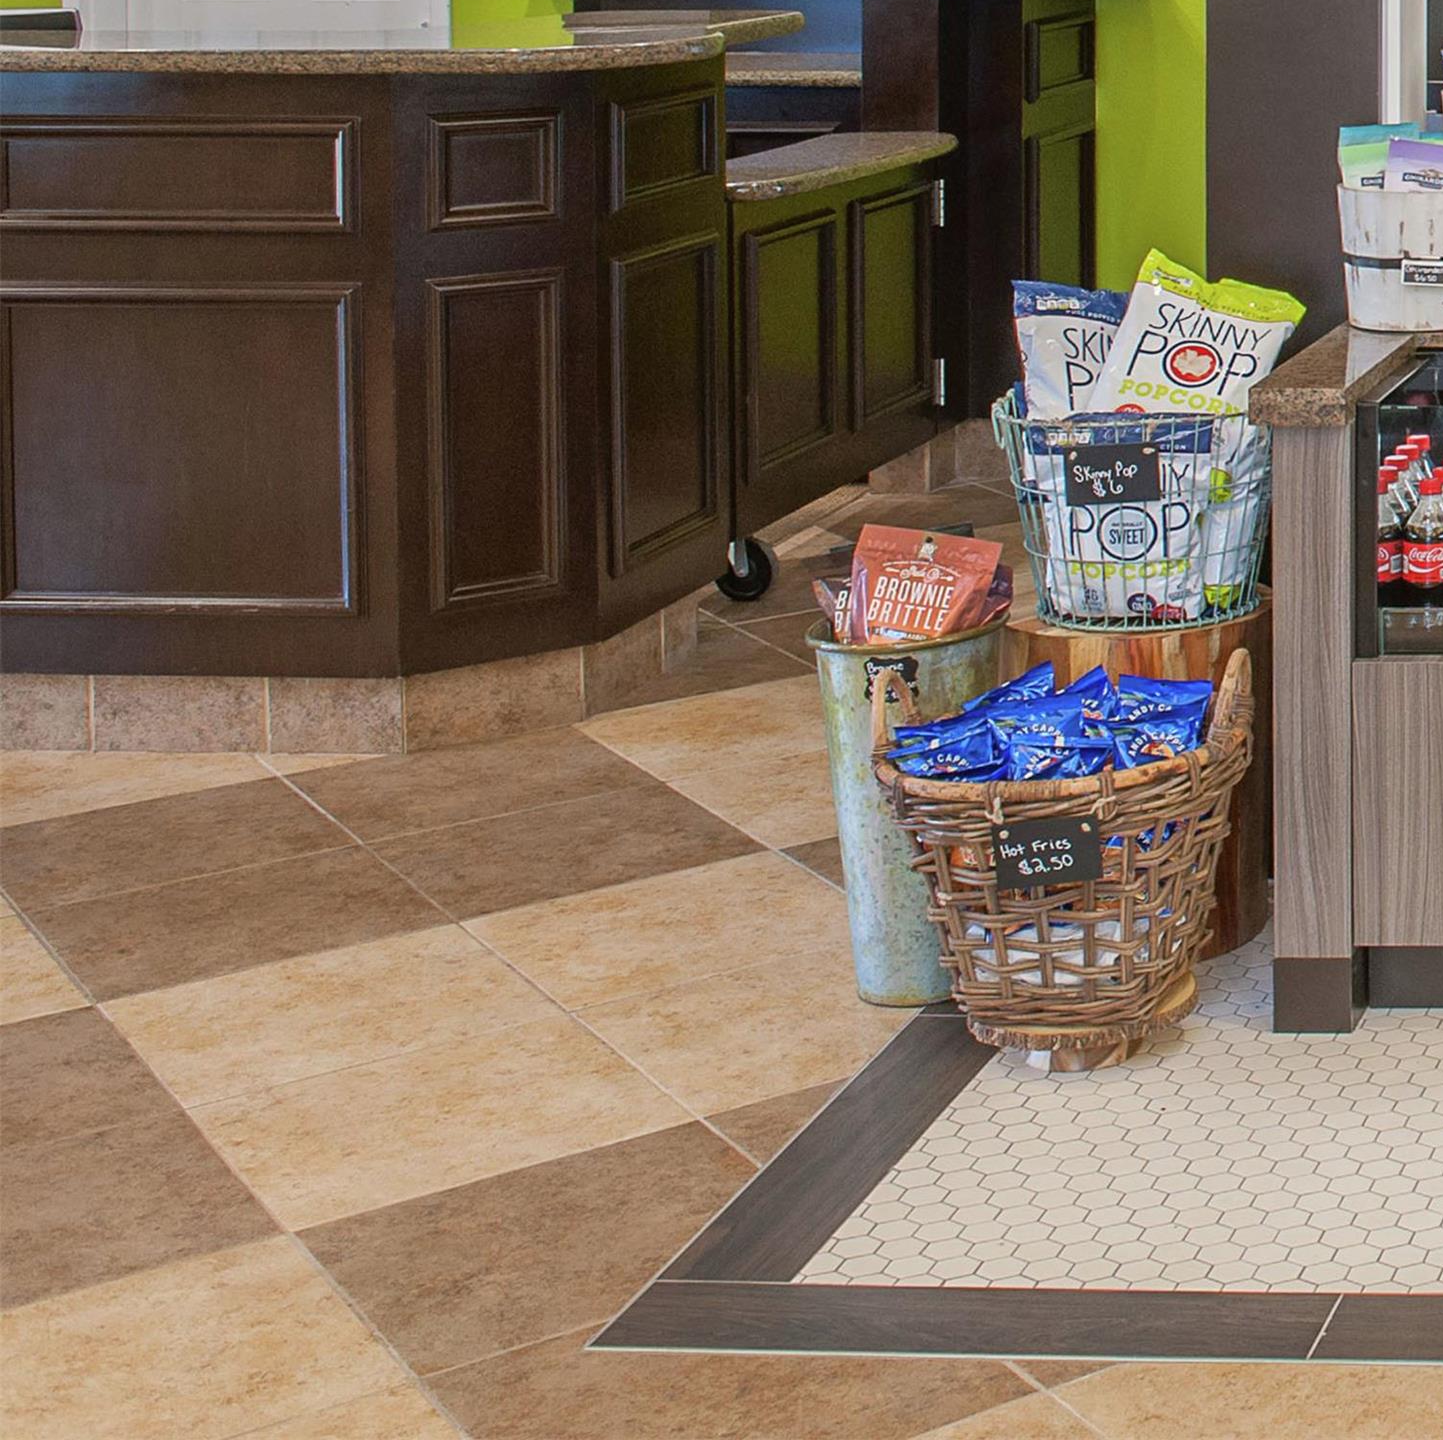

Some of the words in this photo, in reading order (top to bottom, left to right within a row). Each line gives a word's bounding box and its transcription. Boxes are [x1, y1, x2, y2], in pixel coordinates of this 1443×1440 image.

[1149, 302, 1272, 351] SKINNY
[1127, 330, 1259, 396] POP
[1069, 502, 1191, 561] POP
[1108, 529, 1146, 545] SWEET
[873, 576, 955, 609] BROWNIE
[868, 599, 949, 631] BRITTLE
[1129, 733, 1148, 757] ANDY
[1000, 844, 1025, 859] Hot
[1032, 839, 1071, 853] Fries
[1018, 855, 1074, 875] $2.50
